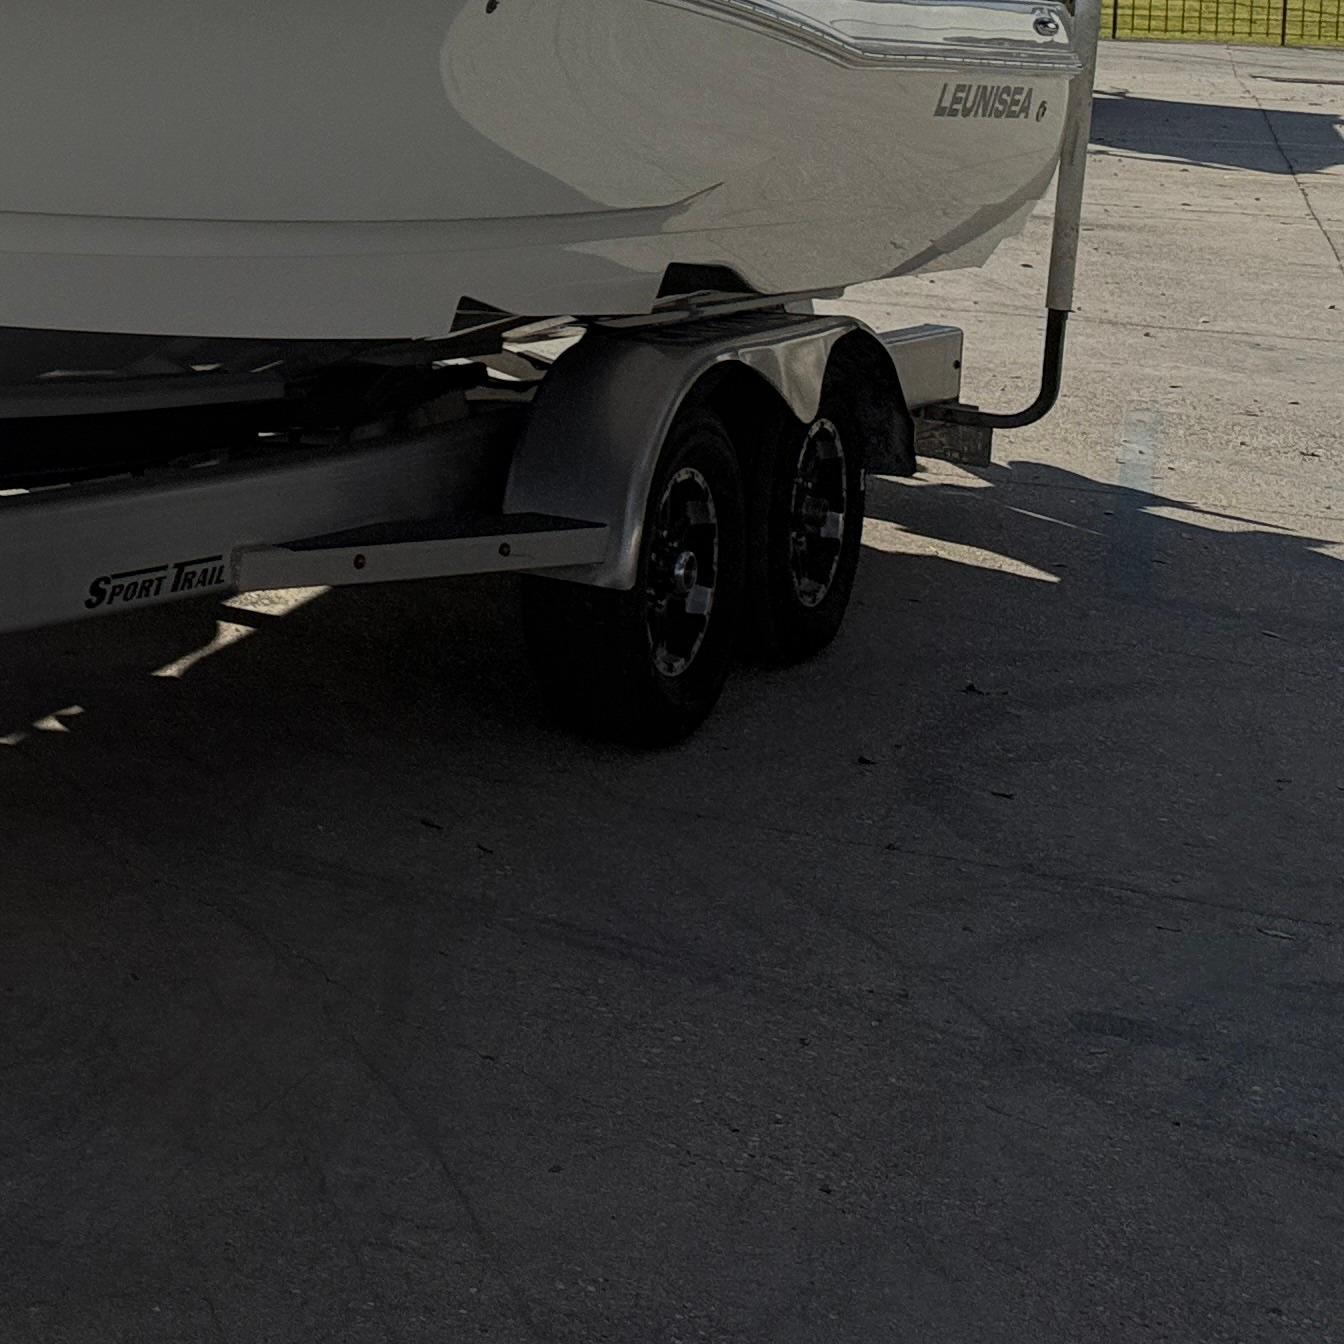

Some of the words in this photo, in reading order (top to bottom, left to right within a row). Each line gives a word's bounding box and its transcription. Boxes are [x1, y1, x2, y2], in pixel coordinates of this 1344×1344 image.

[933, 82, 1034, 120] LEUNISEA
[84, 564, 169, 609] SPORT
[170, 555, 225, 593] TRAIL
